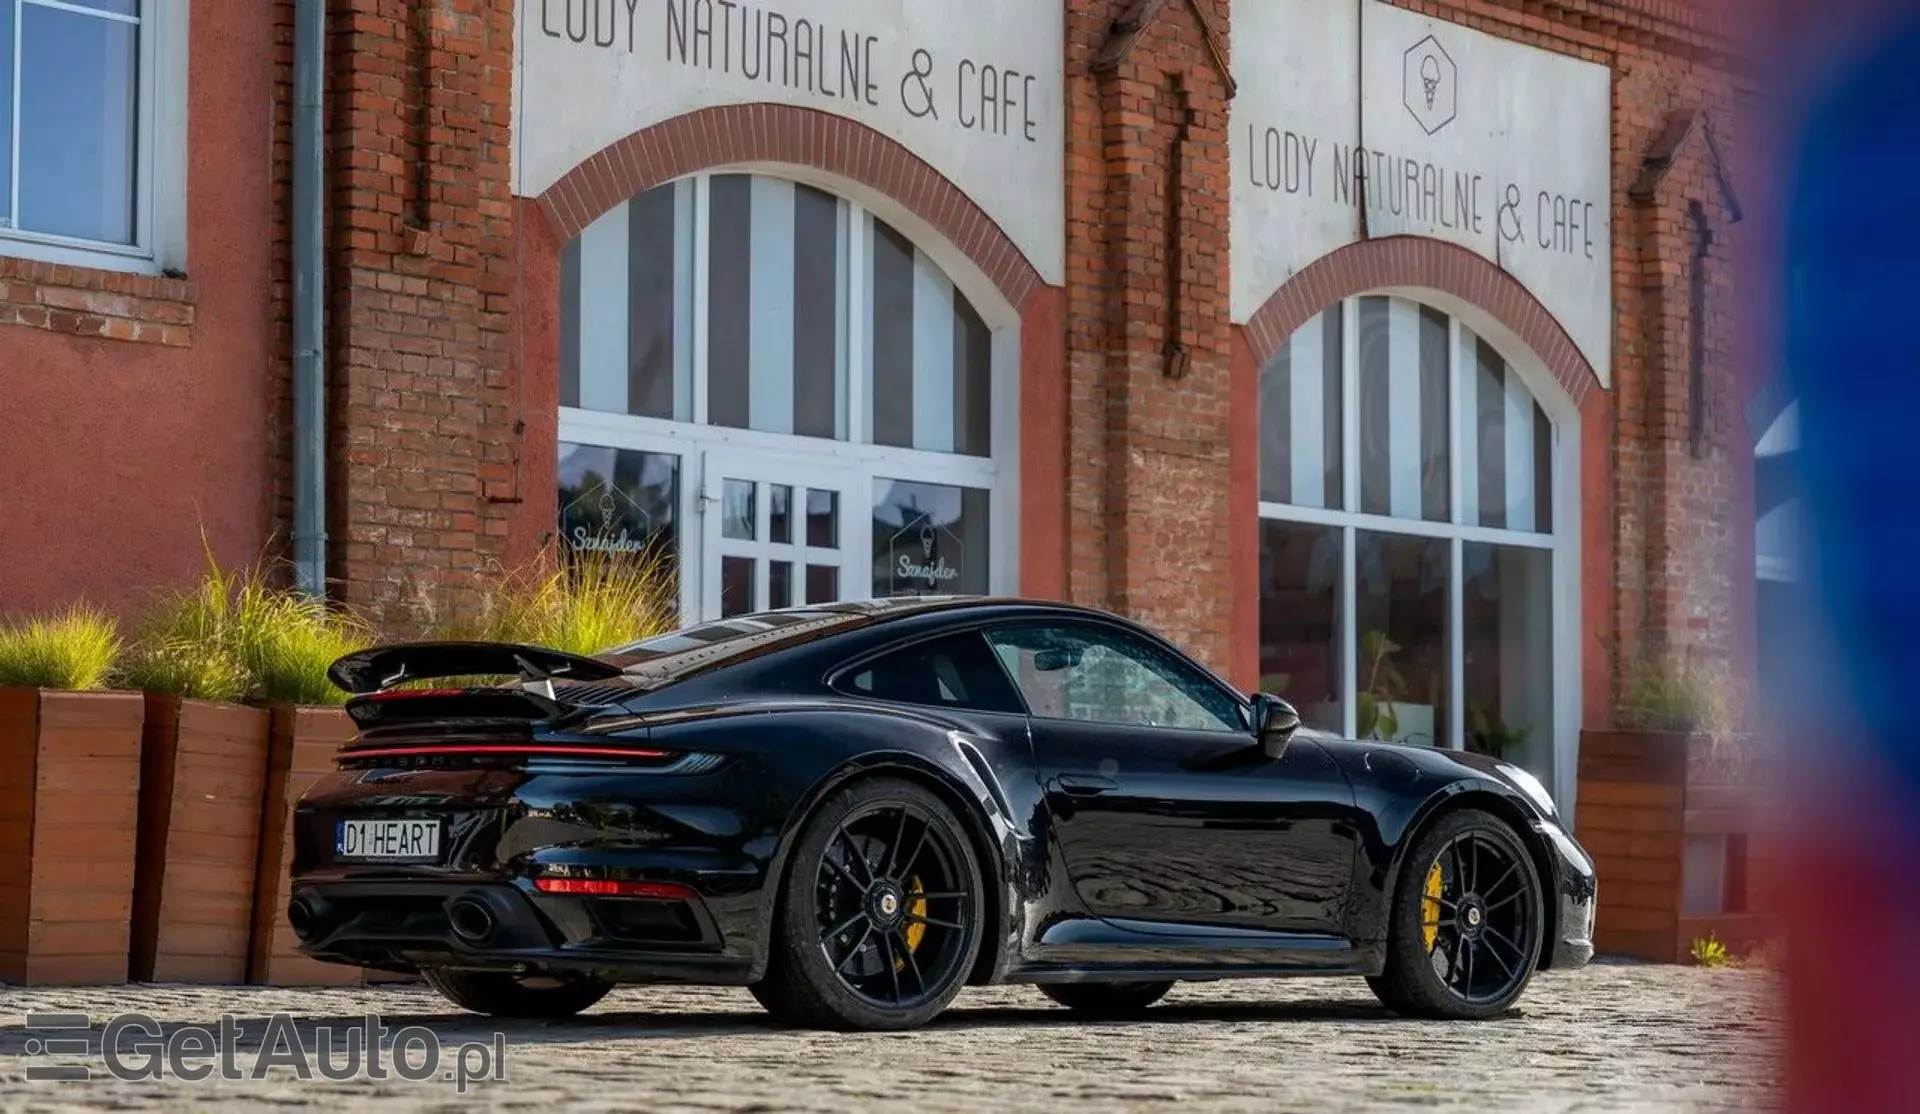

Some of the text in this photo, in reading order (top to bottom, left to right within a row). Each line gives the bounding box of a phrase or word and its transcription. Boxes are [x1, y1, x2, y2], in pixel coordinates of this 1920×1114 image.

[666, 0, 878, 105] NATURALNE
[901, 48, 939, 120] &
[958, 59, 1036, 142] CAFE
[1249, 123, 1594, 259] LODY NATURALNE & CAFE
[346, 823, 437, 854] D1 HEART
